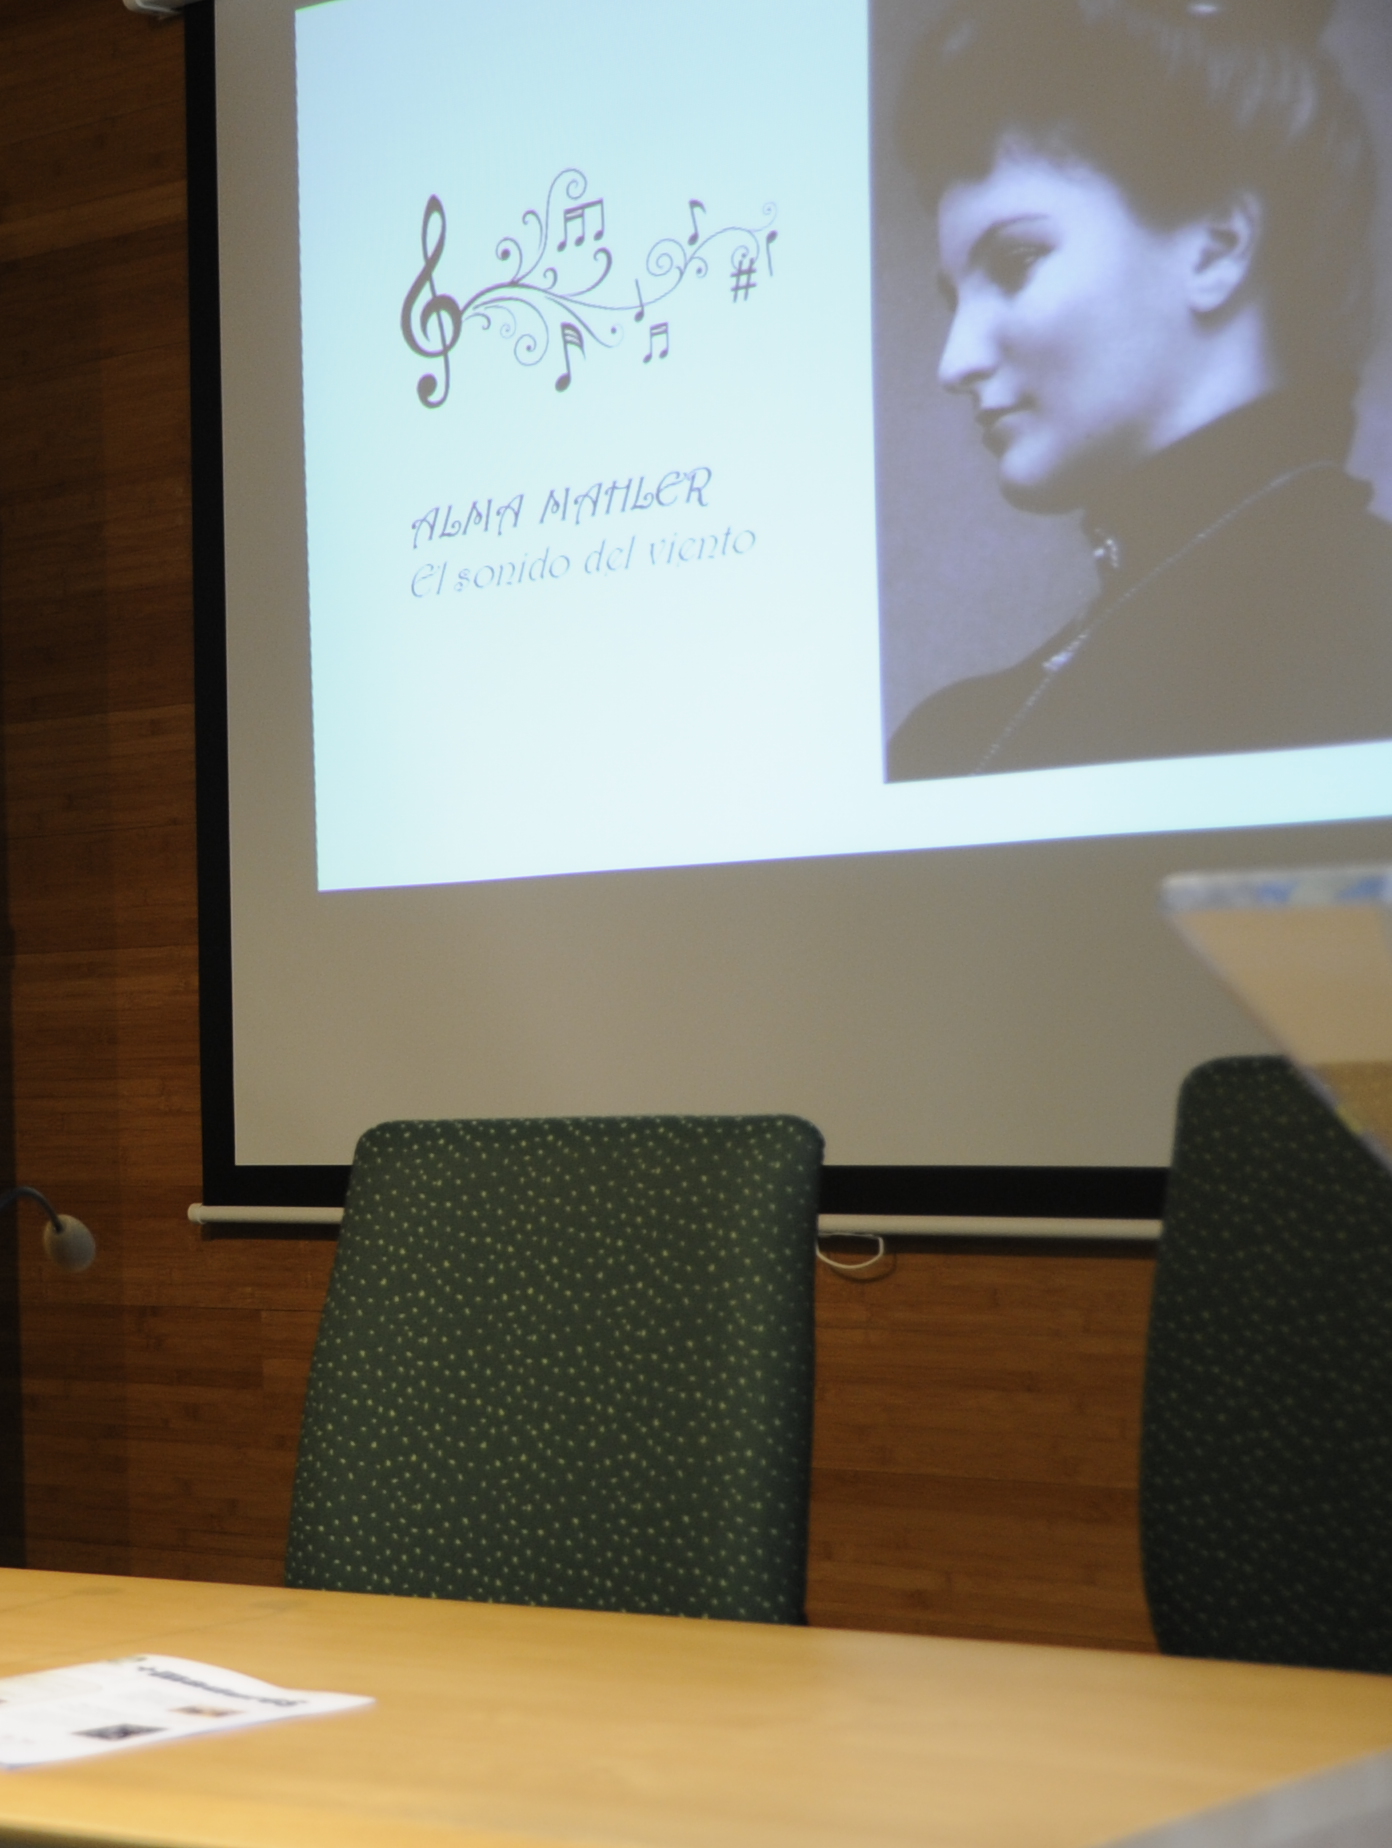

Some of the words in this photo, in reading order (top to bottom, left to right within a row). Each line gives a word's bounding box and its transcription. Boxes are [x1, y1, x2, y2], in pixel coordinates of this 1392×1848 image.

[411, 493, 525, 550] ALMA
[539, 465, 713, 526] MAHLER
[410, 561, 448, 599] El
[453, 546, 571, 593] sonido
[584, 534, 636, 576] del
[649, 525, 757, 568] viento
